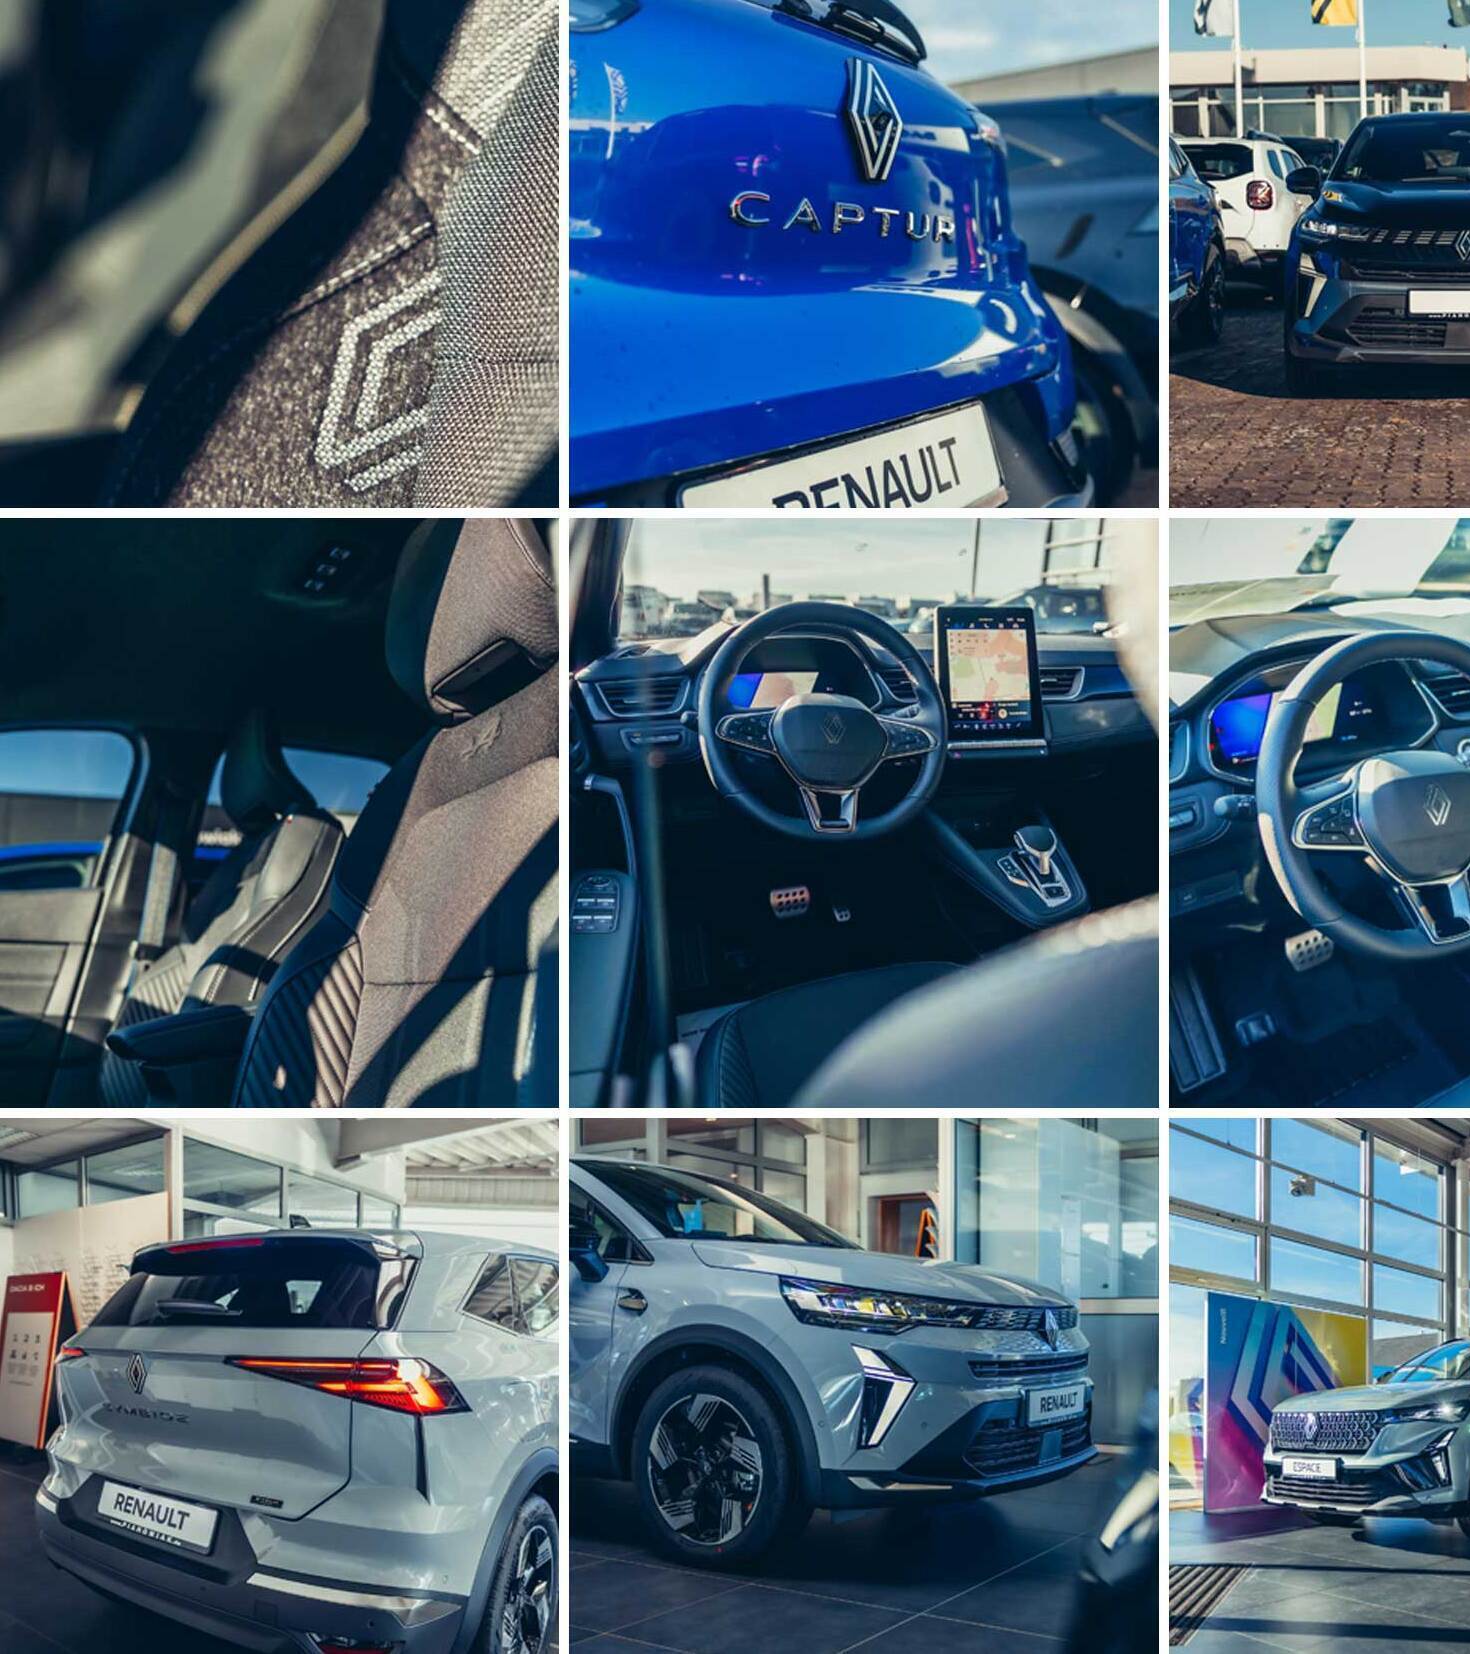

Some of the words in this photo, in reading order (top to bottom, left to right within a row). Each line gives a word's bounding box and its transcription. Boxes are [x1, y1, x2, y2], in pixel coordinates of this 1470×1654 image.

[729, 190, 956, 243] CAPTUR
[1040, 1392, 1078, 1413] RENAULT
[113, 1492, 190, 1531] RENAULT
